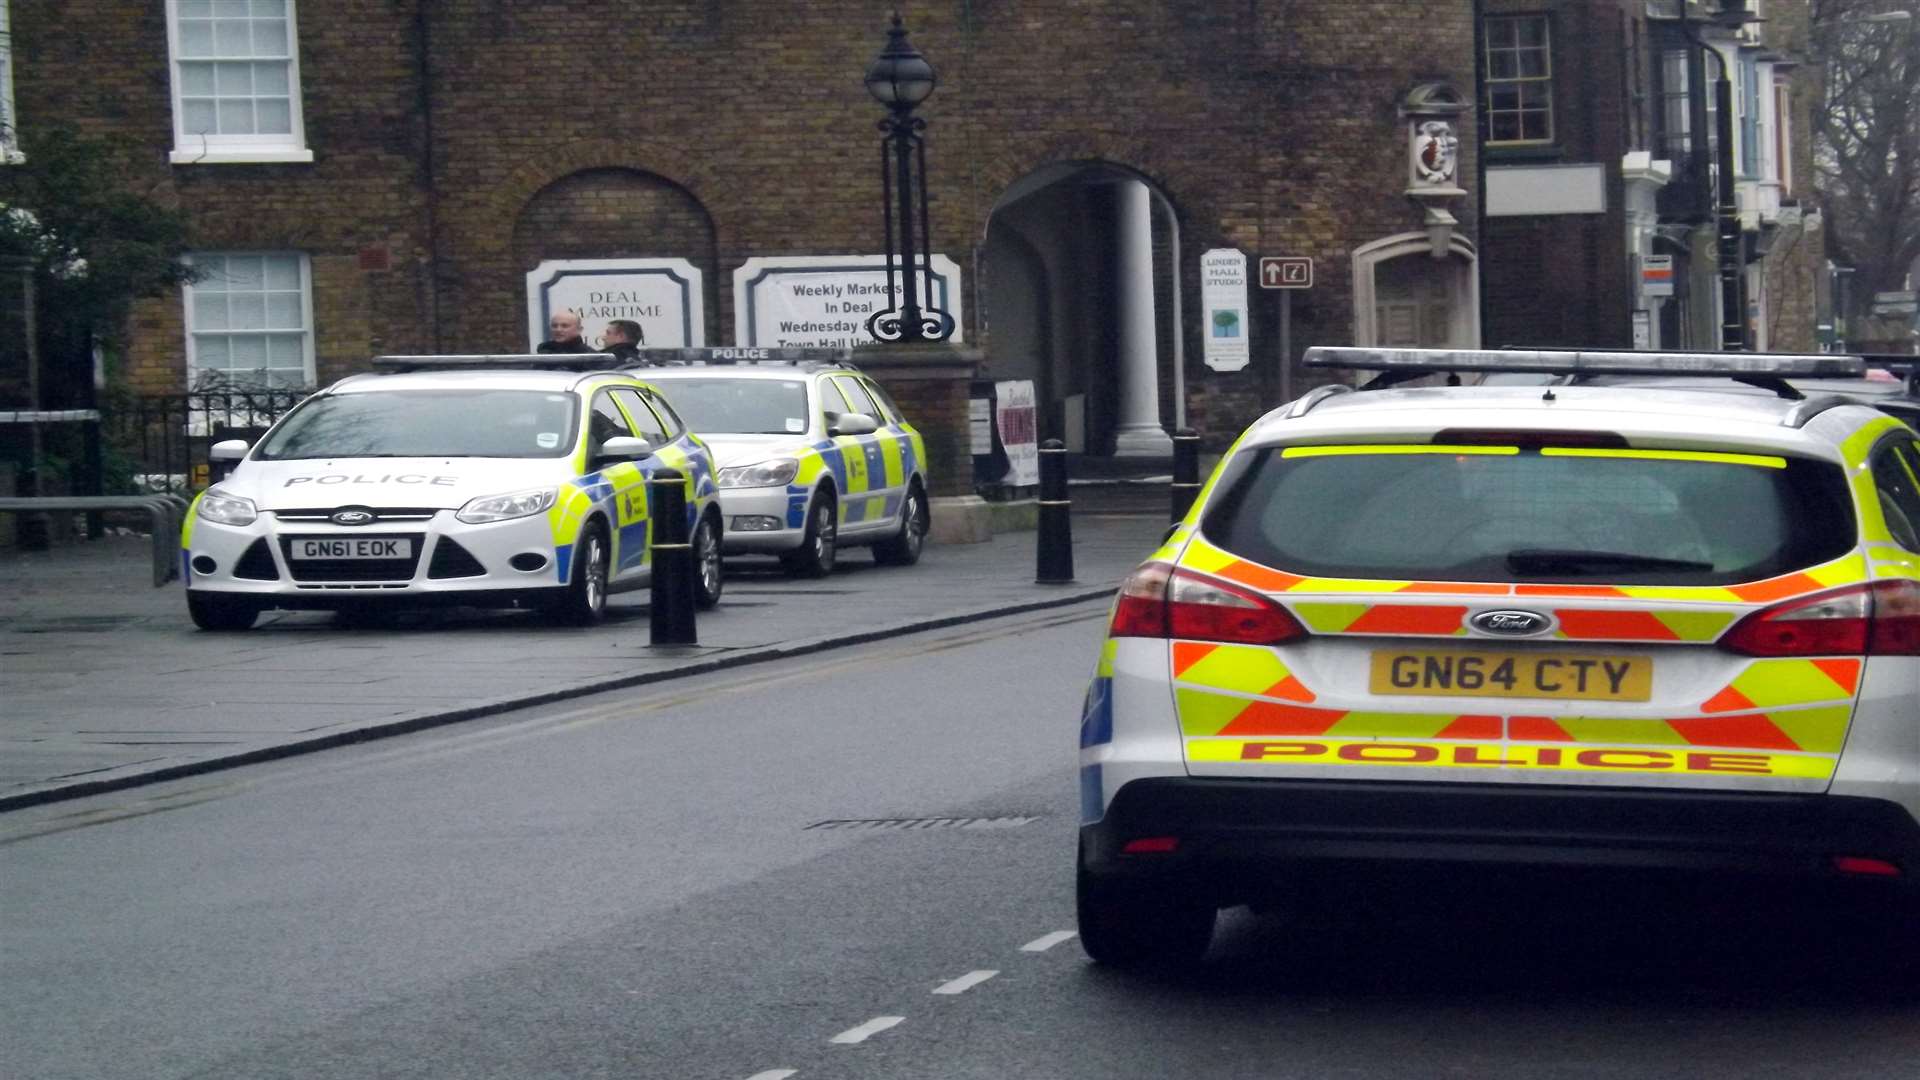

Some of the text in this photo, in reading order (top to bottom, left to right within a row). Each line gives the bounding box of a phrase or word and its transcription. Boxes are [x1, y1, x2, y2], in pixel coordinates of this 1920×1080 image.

[1207, 258, 1241, 266] LINDEN
[1209, 268, 1240, 276] HALL
[590, 291, 641, 303] DEAL
[793, 283, 903, 298] Weekly Markes
[825, 301, 873, 313] In Deal
[780, 320, 858, 334] Wednesday
[712, 349, 769, 359] POLICE
[284, 474, 460, 488] POLICE
[304, 541, 398, 556] GN61 EOK
[1488, 614, 1532, 629] Ford
[1391, 655, 1630, 694] GN64 CTY
[1240, 742, 1773, 774] POLICE
